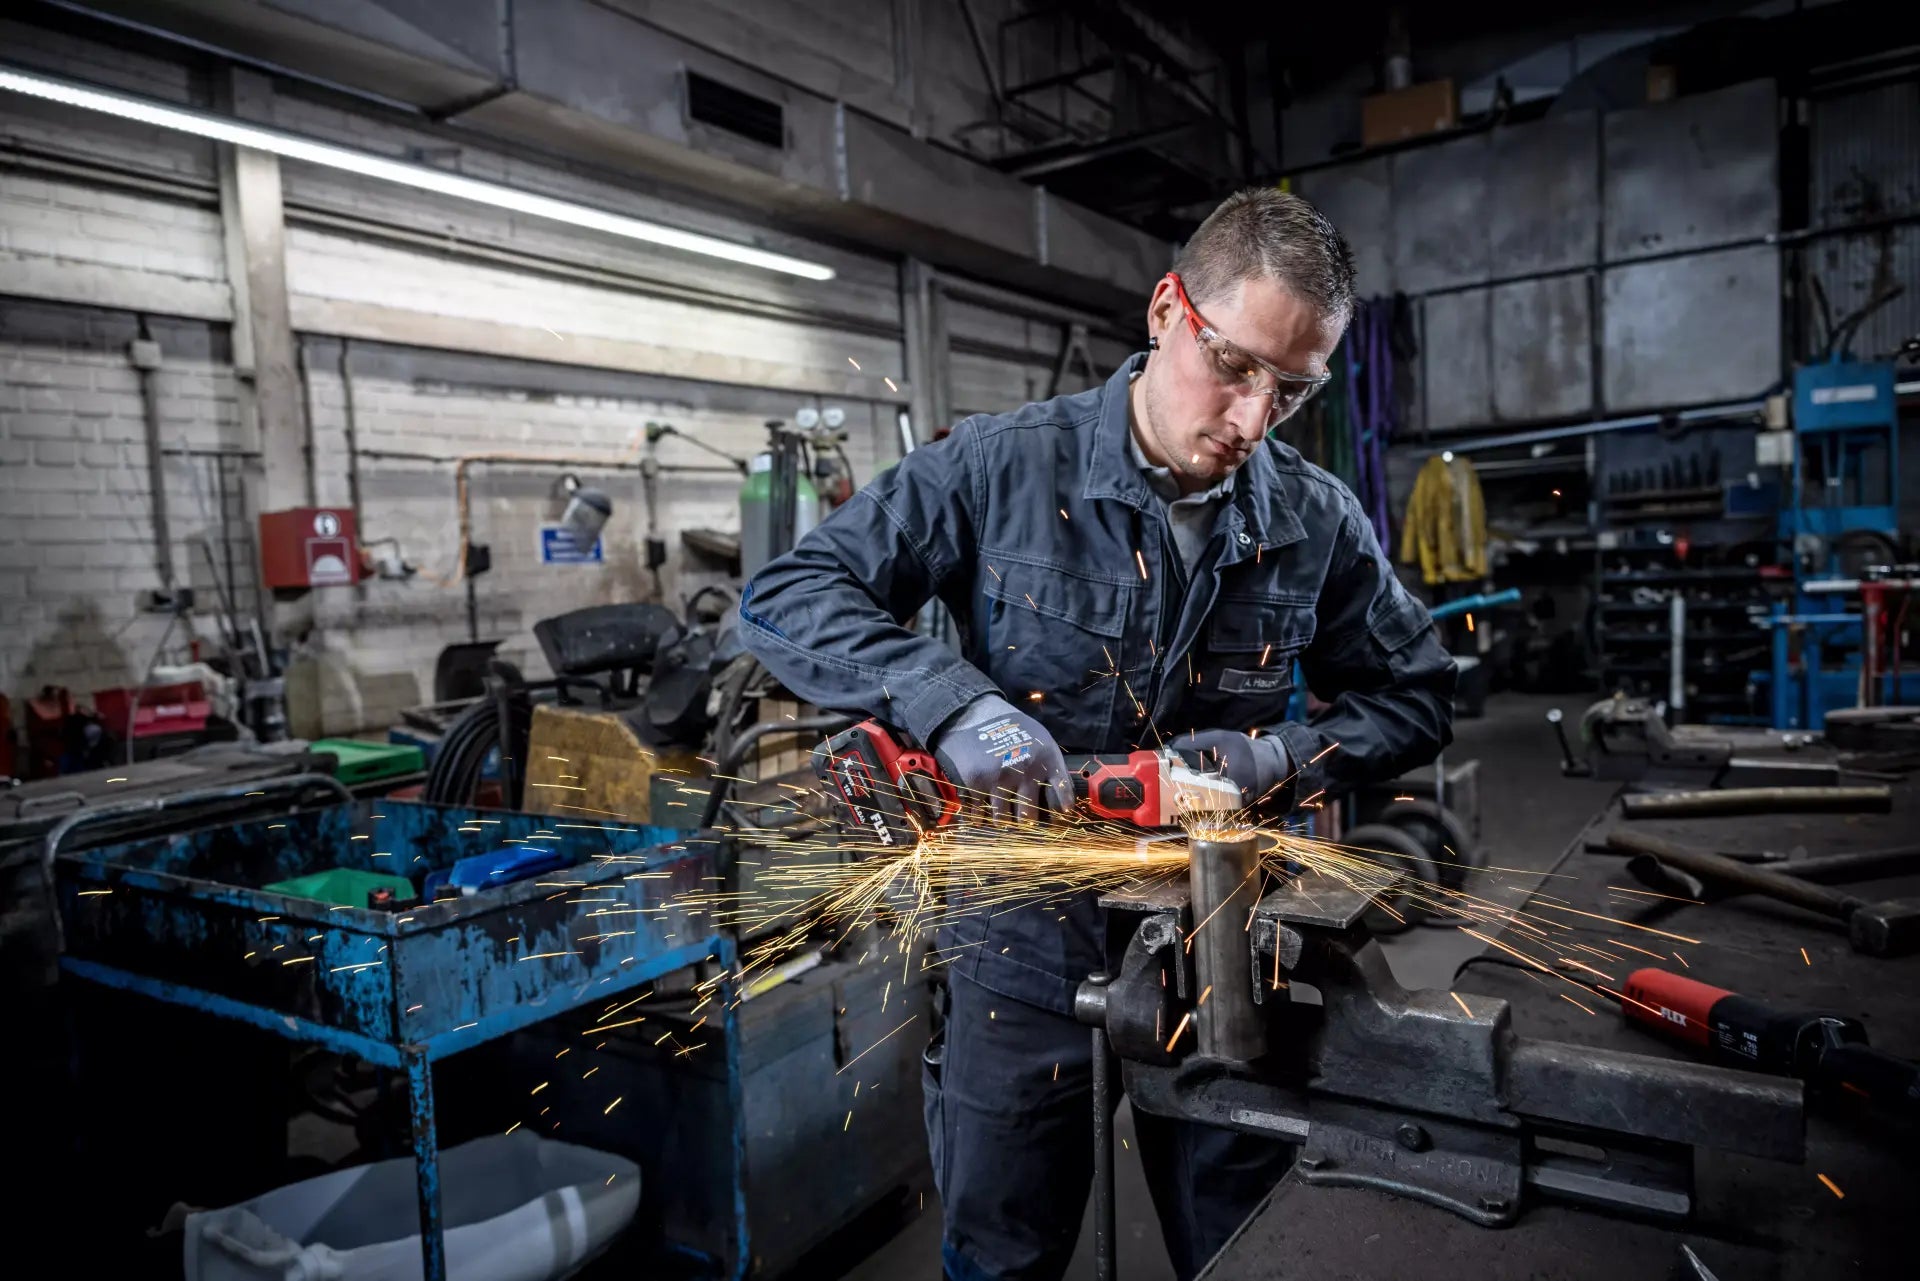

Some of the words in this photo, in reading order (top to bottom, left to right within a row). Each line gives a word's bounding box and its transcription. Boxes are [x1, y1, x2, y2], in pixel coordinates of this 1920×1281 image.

[843, 784, 853, 797] 18V
[870, 812, 893, 847] FLEX
[1660, 1006, 1687, 1028] FLEX
[1743, 1032, 1758, 1042] FLEX
